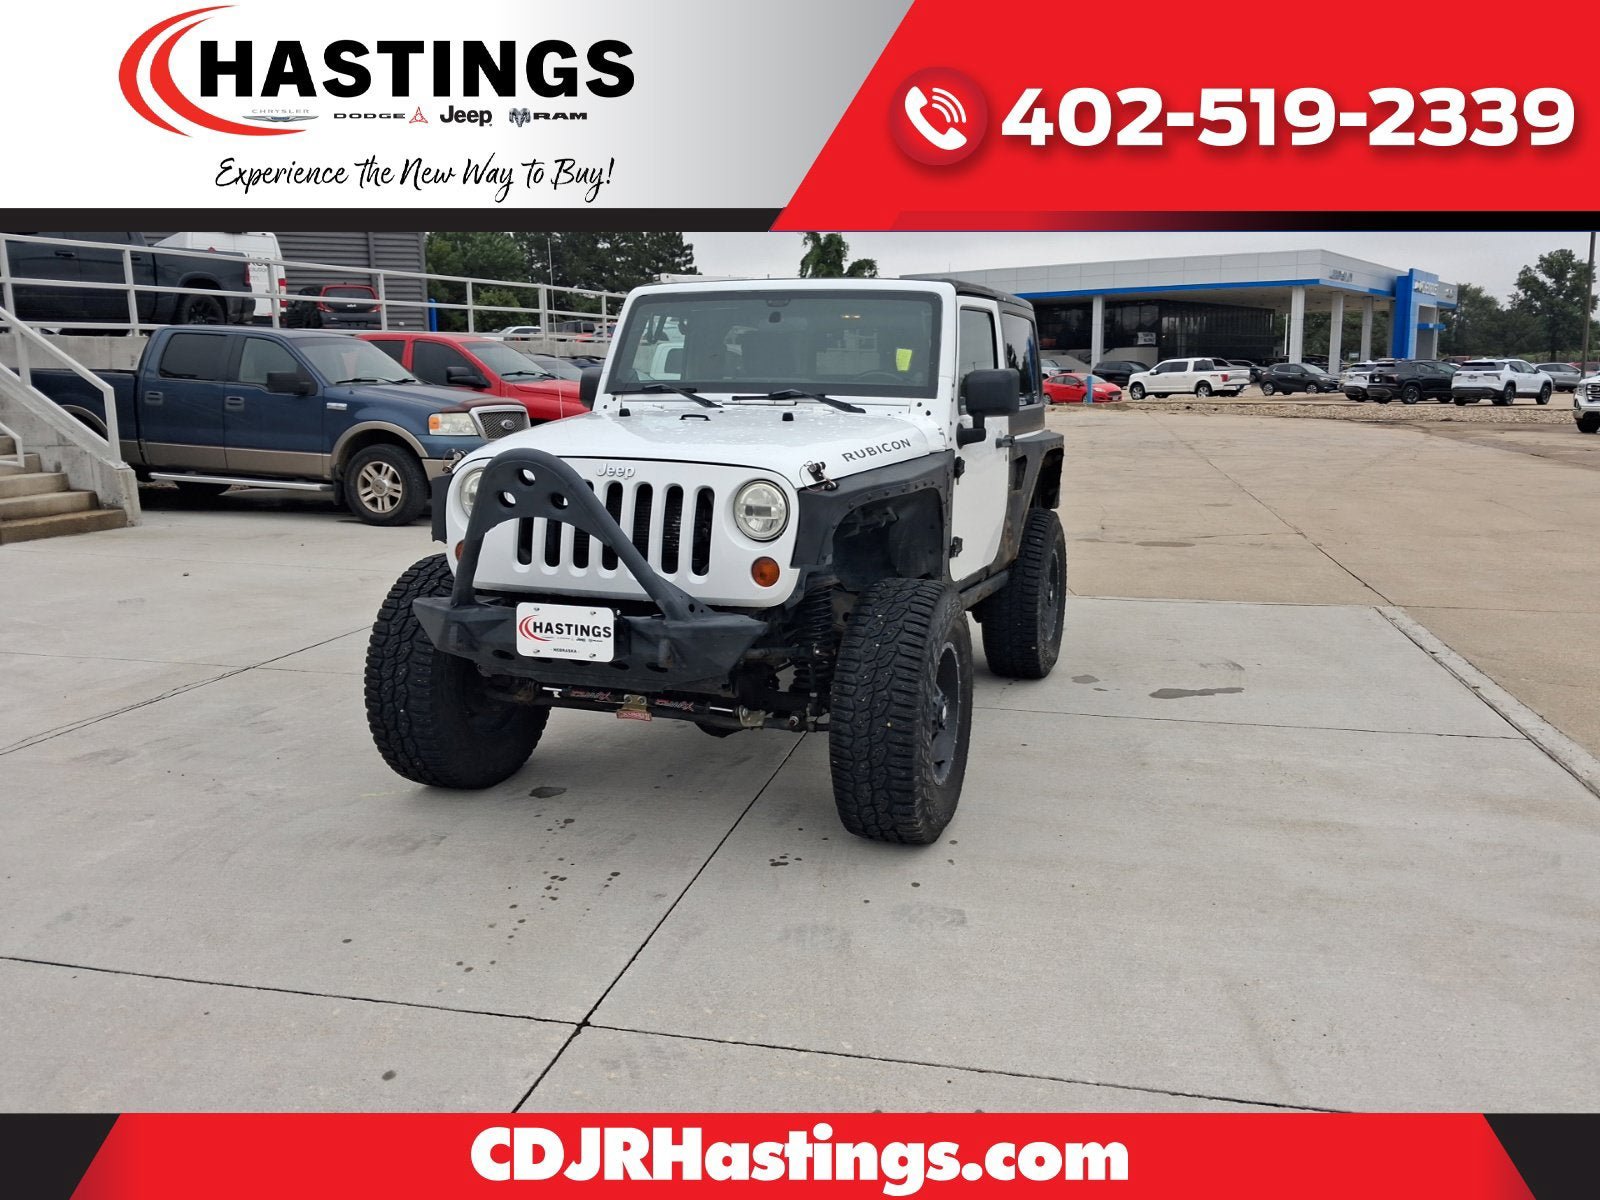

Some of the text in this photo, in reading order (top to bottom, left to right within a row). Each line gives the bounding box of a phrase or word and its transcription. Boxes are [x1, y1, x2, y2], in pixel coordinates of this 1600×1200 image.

[841, 438, 911, 462] RUBICON
[597, 463, 636, 480] Jeep
[533, 621, 612, 638] HASTINGS
